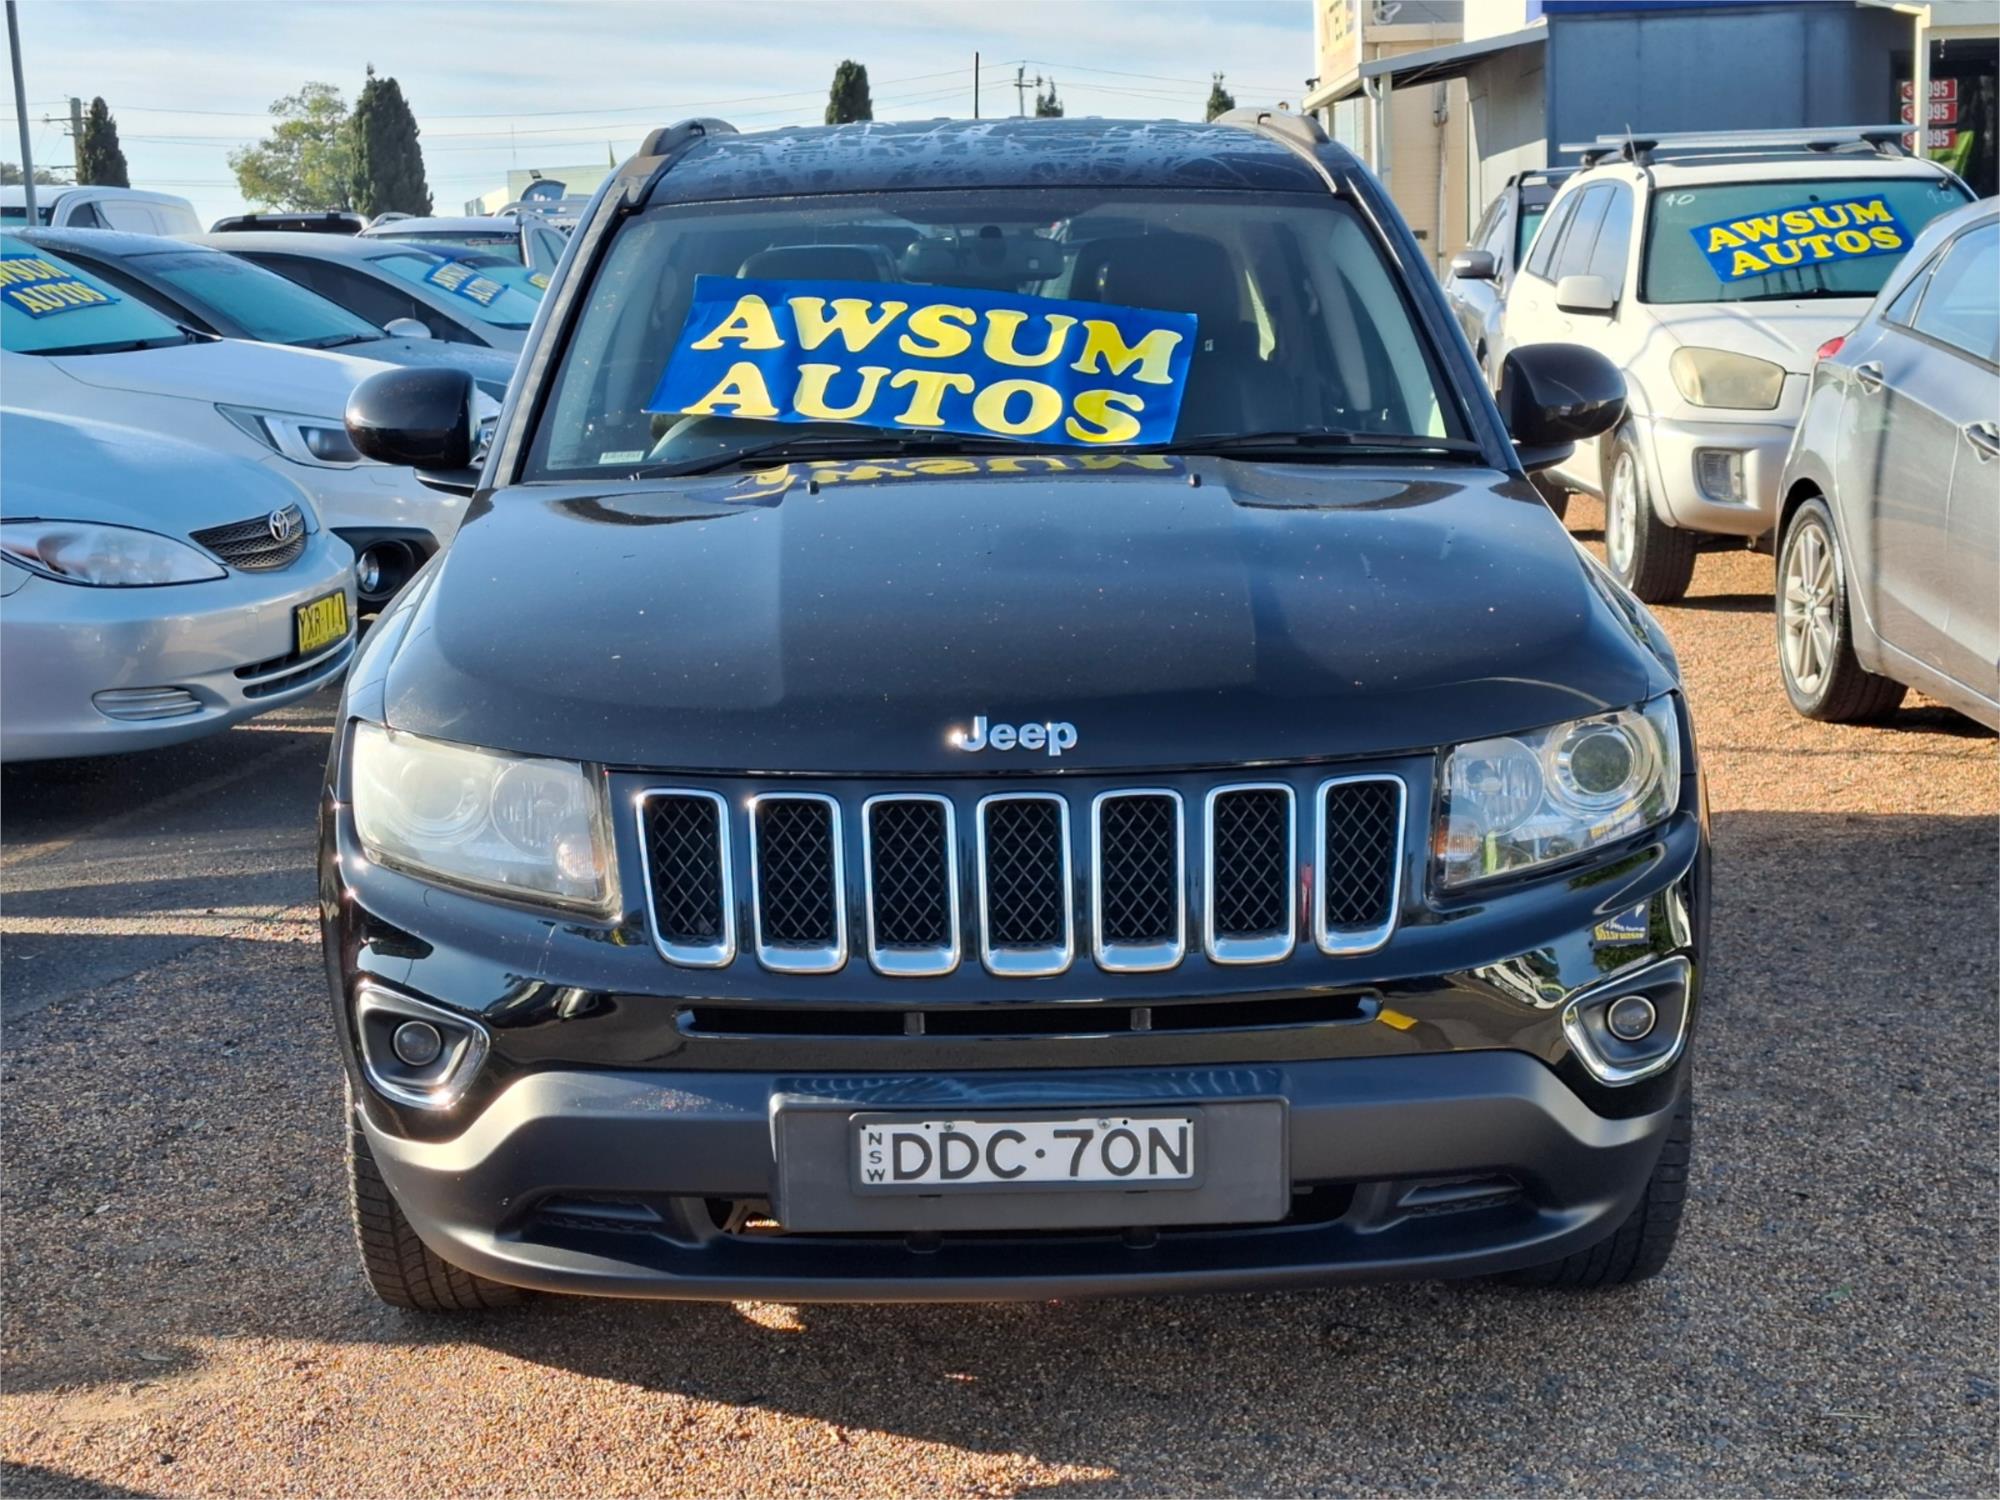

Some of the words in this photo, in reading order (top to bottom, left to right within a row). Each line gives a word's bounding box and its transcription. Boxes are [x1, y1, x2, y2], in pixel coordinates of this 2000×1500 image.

[1707, 200, 1894, 253] AWSUM
[1730, 225, 1903, 276] AUTOS
[0, 258, 71, 287] WSUM
[9, 281, 108, 313] AUTOS
[691, 294, 1182, 384] AWSUM
[681, 362, 1145, 443] AUTOS
[951, 715, 1078, 756] Jeep
